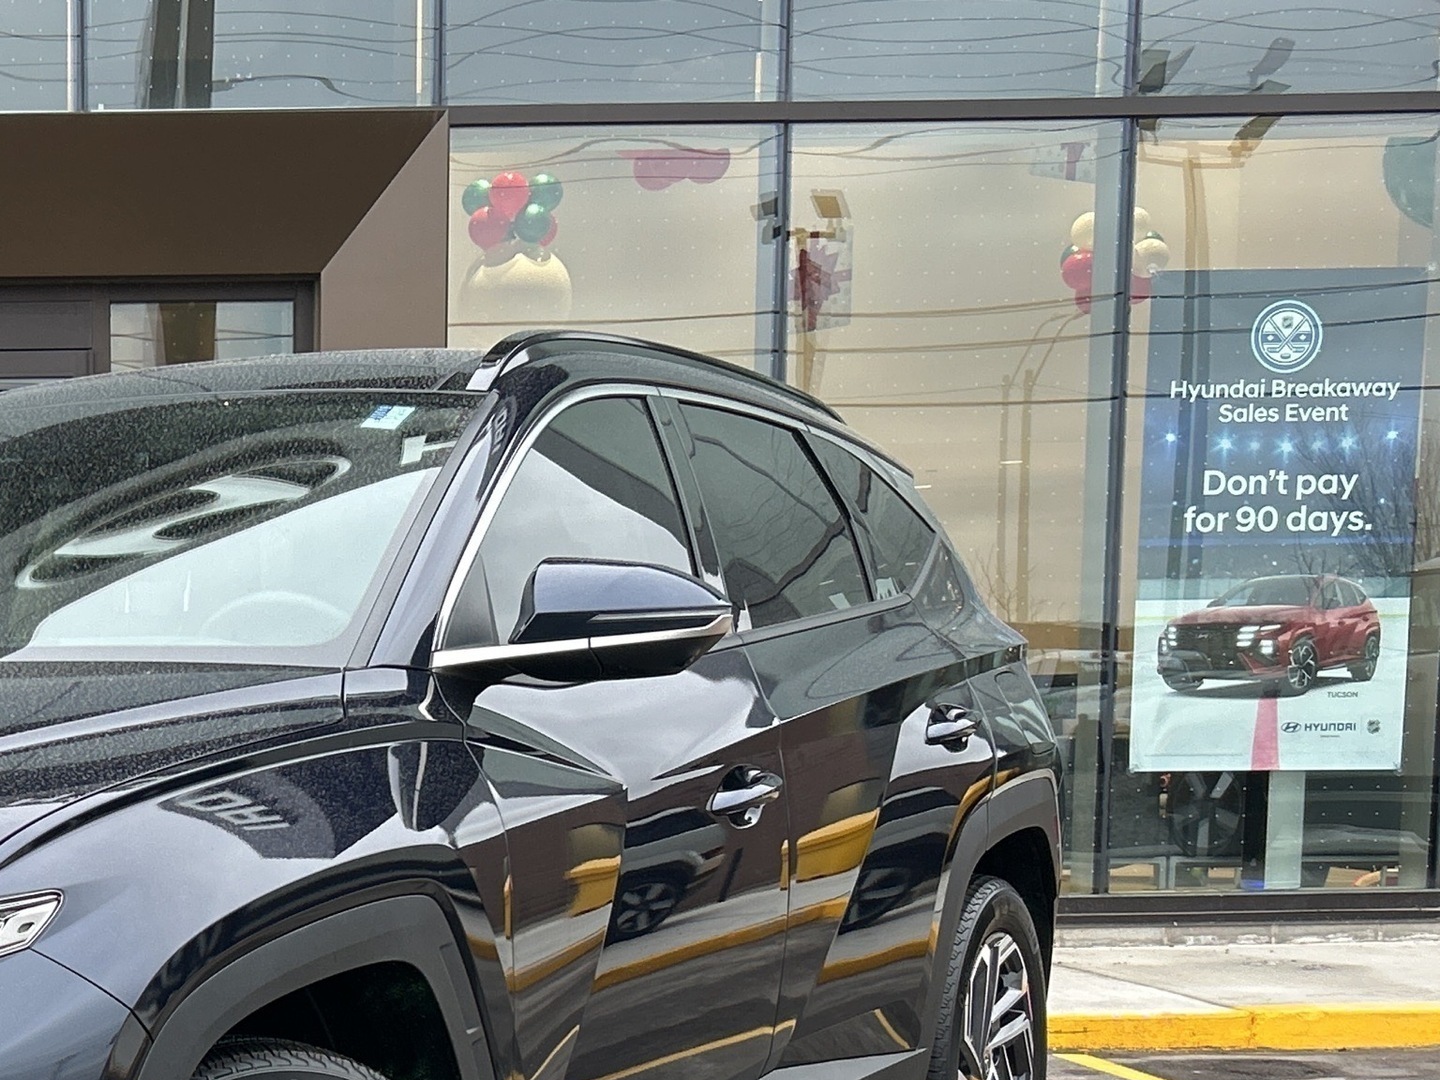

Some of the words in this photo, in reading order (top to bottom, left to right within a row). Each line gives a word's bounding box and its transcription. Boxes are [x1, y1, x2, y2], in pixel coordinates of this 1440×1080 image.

[1170, 379, 1266, 402] Hyundai
[1271, 378, 1400, 400] Breakaway
[1218, 404, 1279, 423] Sales
[1285, 403, 1349, 422] Event
[1203, 469, 1289, 496] Don't
[1295, 473, 1358, 500] pay
[1184, 506, 1230, 532] for
[1235, 506, 1278, 532] 90
[1286, 505, 1372, 536] days.
[1304, 722, 1357, 732] HYUNDAI
